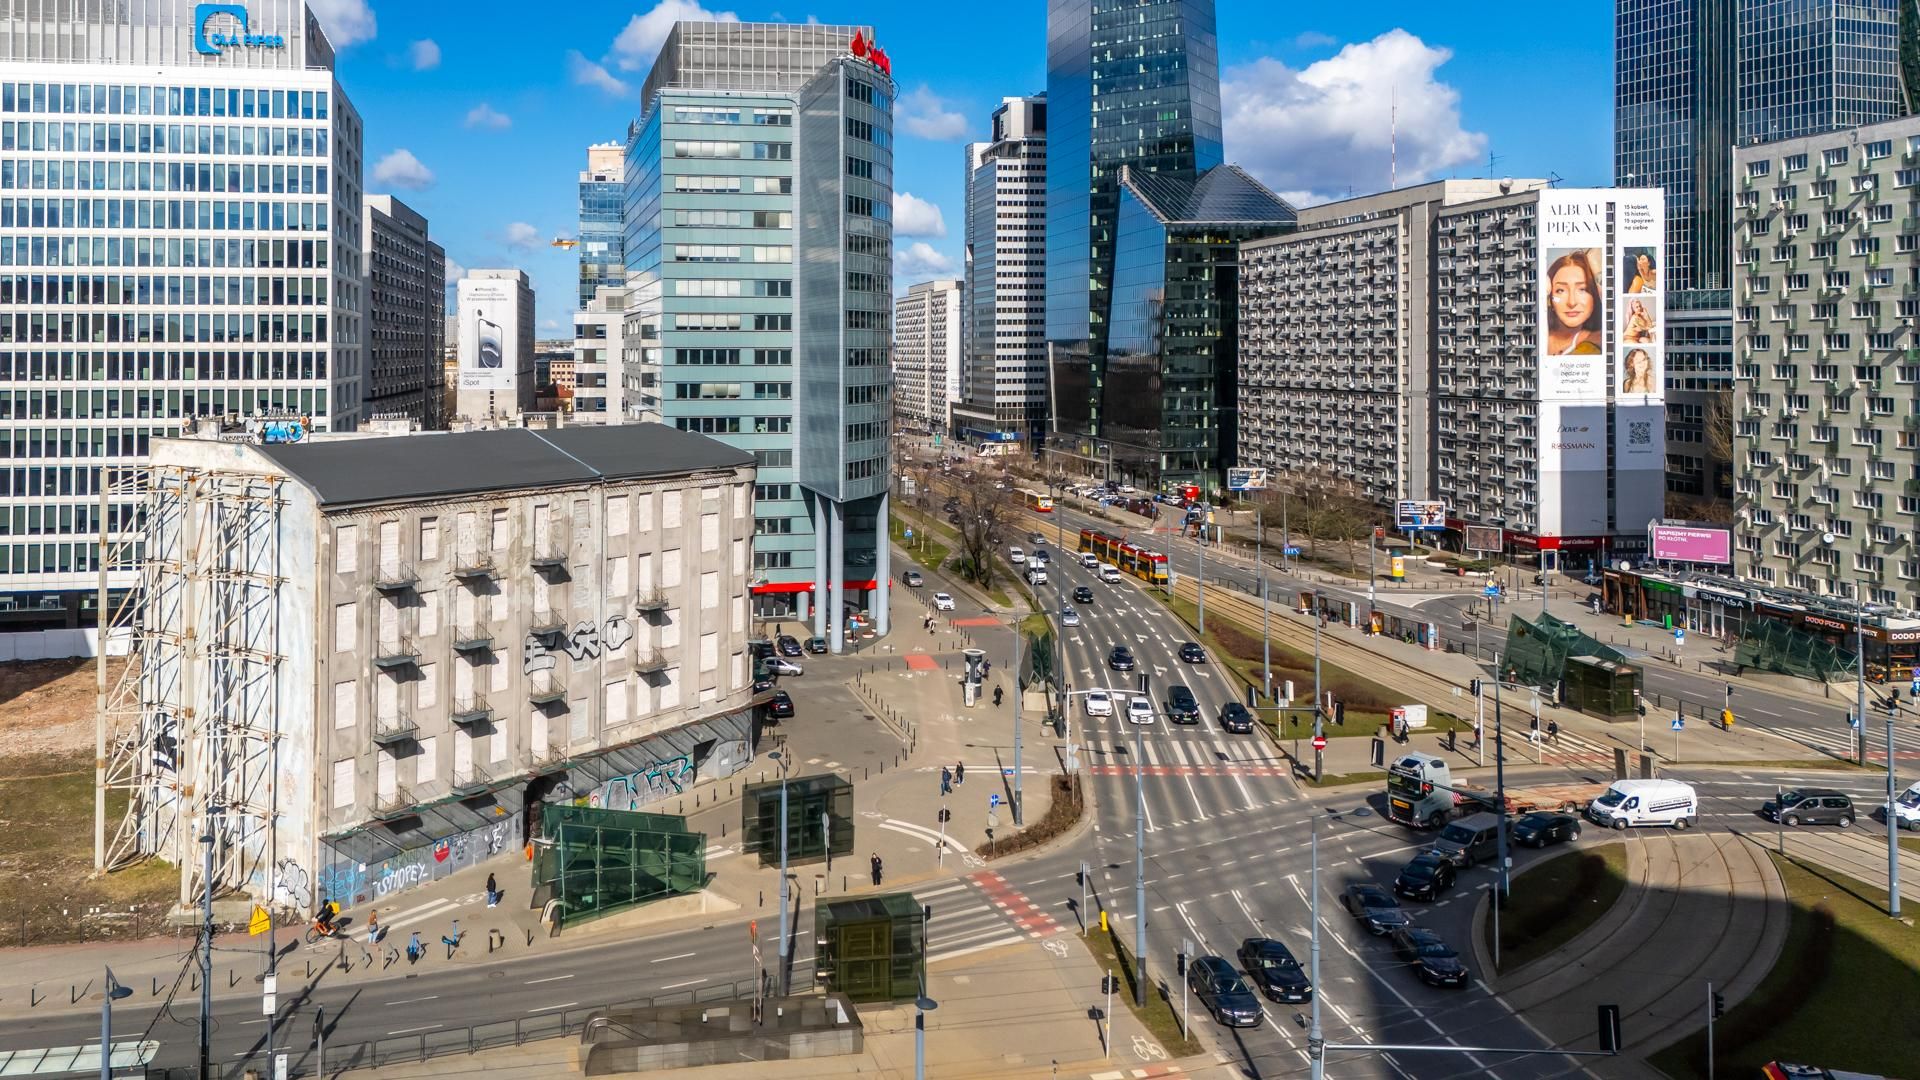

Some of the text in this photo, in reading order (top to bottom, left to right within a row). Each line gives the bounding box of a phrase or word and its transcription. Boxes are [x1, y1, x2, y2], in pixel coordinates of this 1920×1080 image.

[244, 35, 284, 48] PIPER
[1550, 204, 1599, 216] ALBUM
[1547, 221, 1601, 236] PIĘKNA
[1557, 424, 1578, 433] Dove
[1804, 615, 1846, 631] DODO PIZZA
